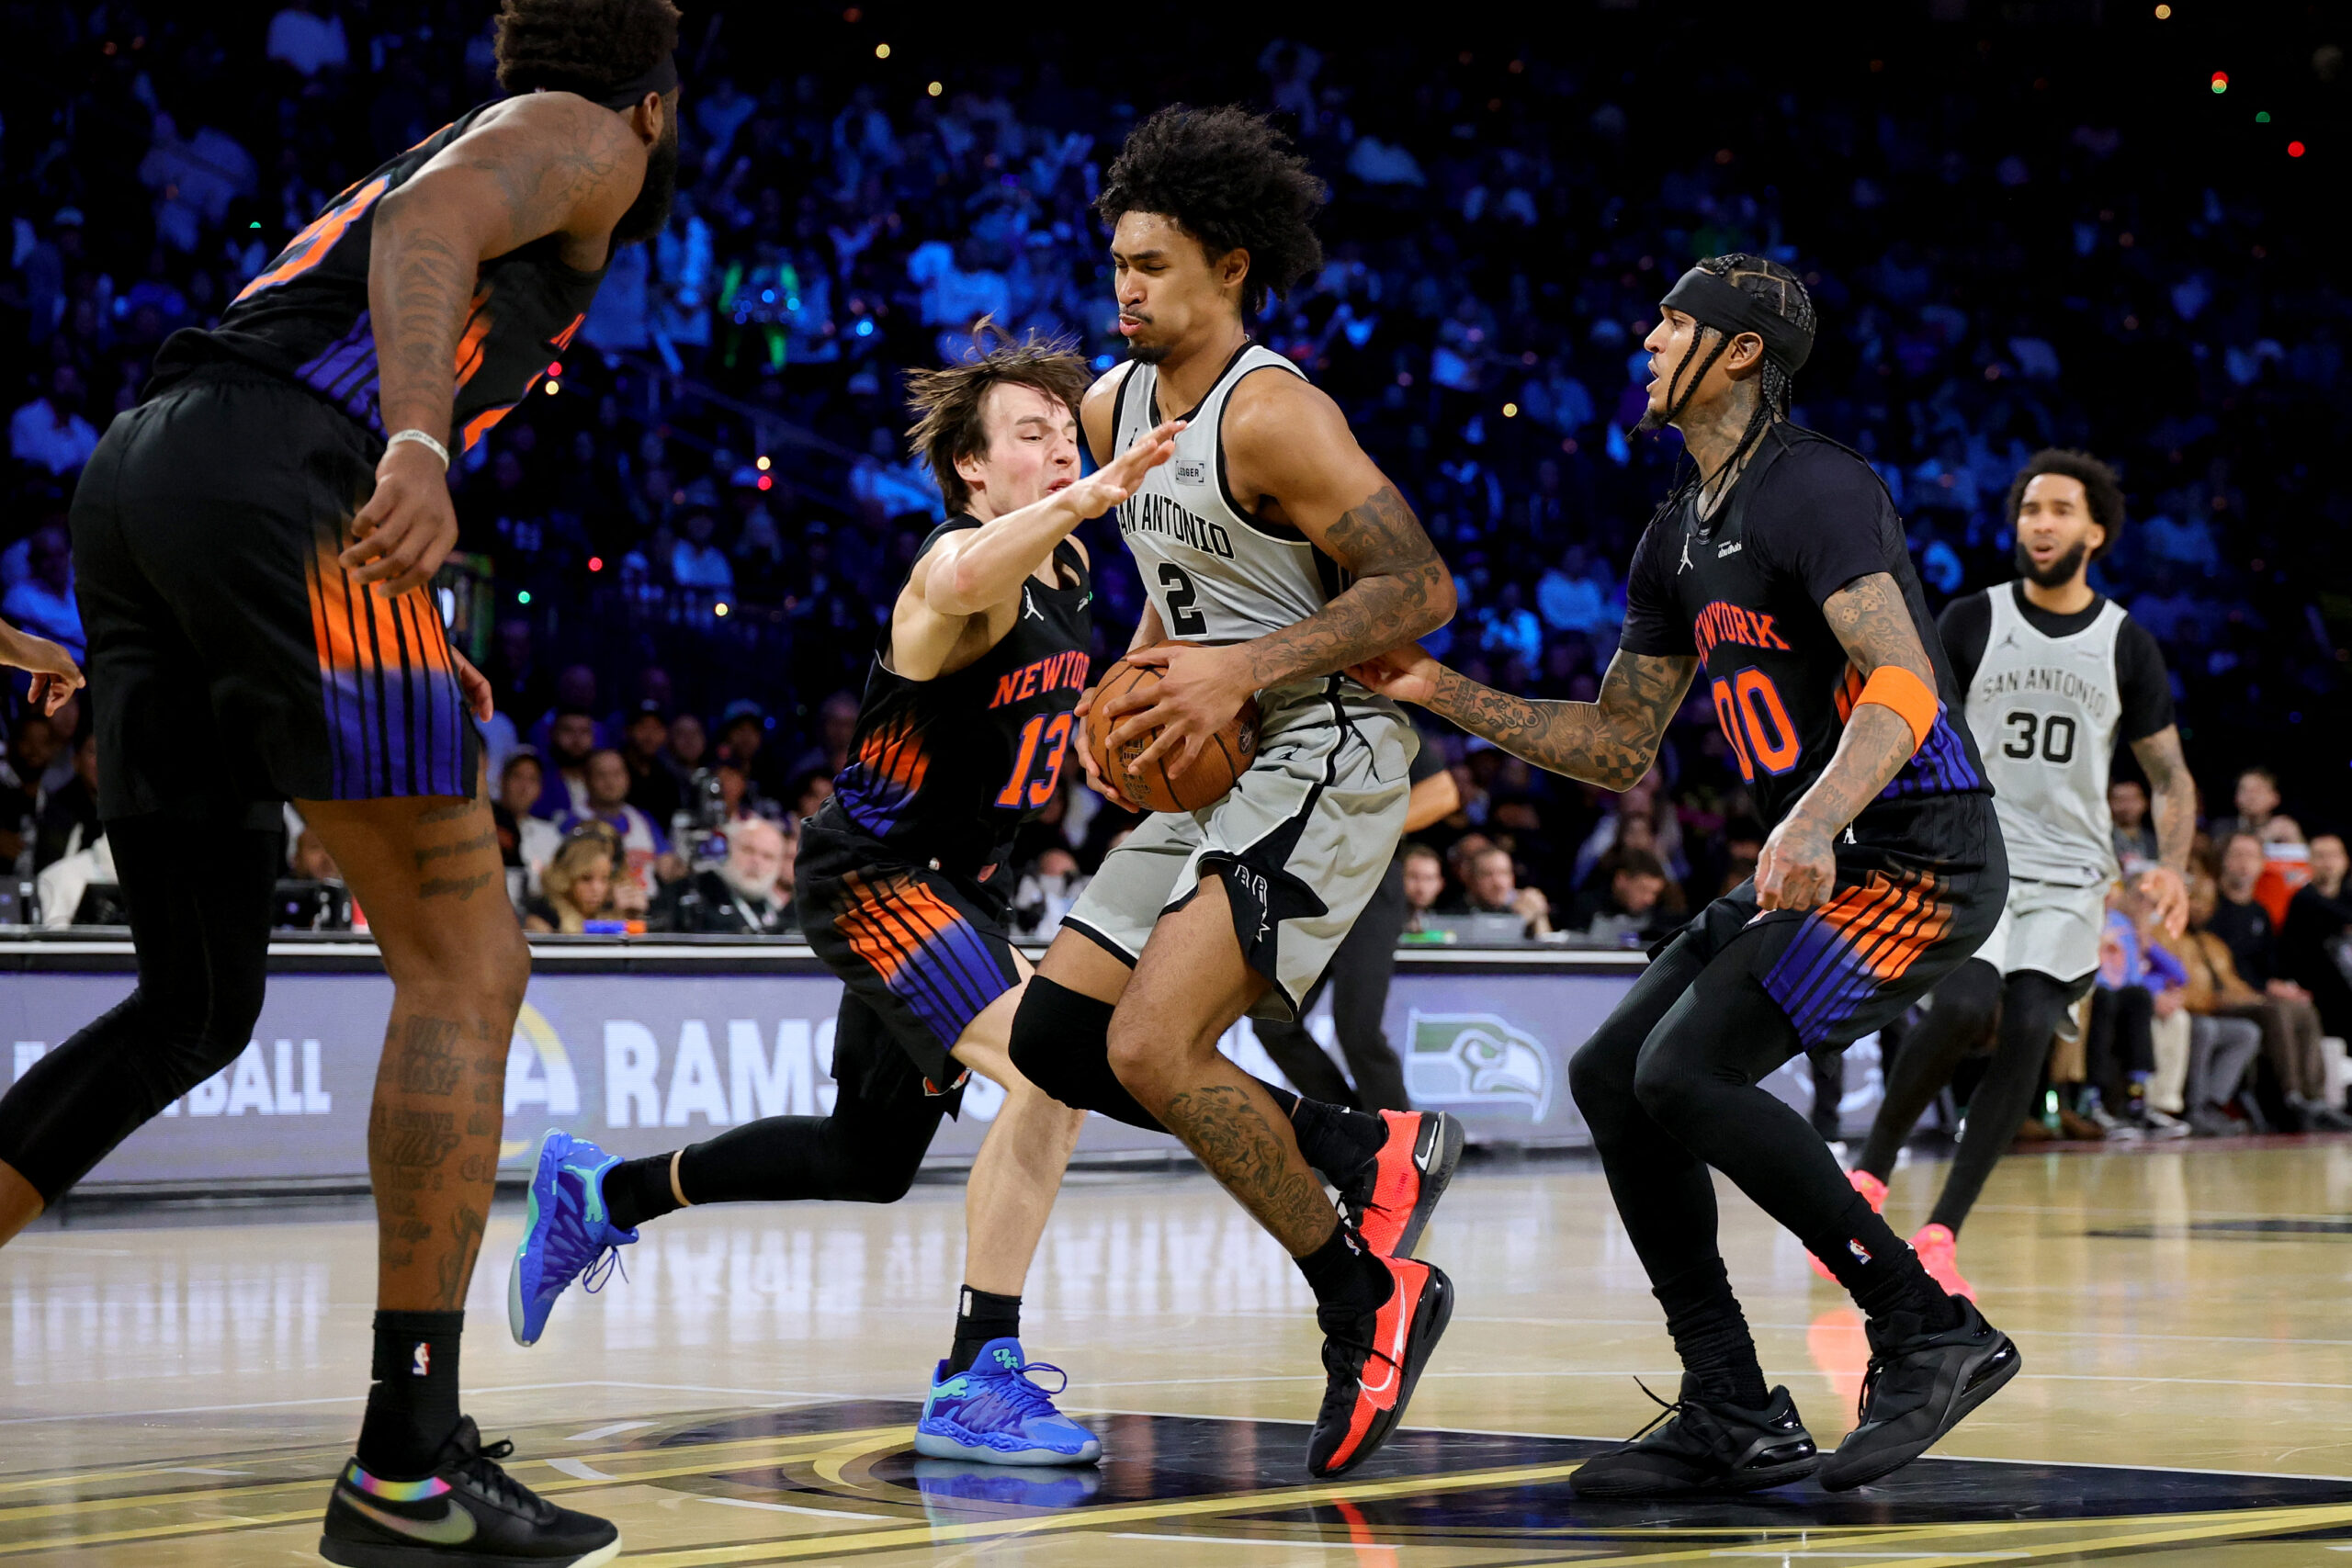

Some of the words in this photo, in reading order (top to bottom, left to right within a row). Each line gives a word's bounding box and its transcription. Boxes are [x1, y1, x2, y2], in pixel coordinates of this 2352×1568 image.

[1177, 467, 1200, 478] LEDGER
[1117, 494, 1137, 536] AN
[1141, 493, 1235, 559] ANTONIO
[1158, 562, 1207, 637] 2
[1712, 665, 1802, 784] 00
[1983, 671, 2018, 702] SAN
[2025, 668, 2108, 717] ANTONIO
[994, 710, 1073, 808] 13
[2003, 711, 2077, 764] 30
